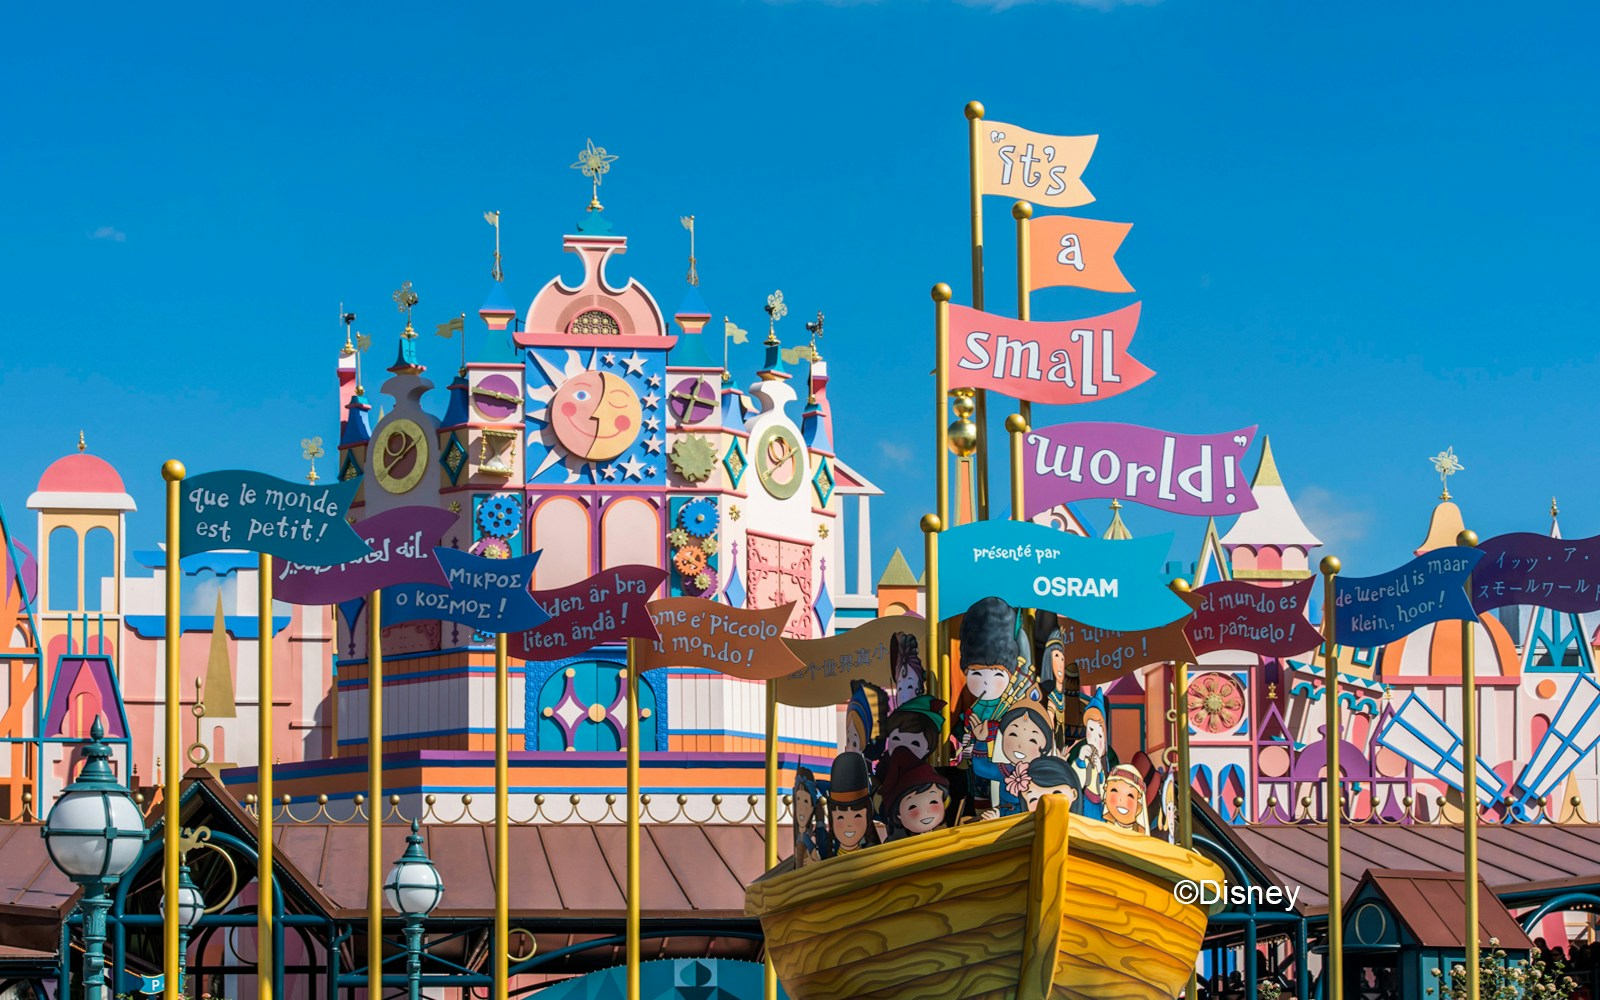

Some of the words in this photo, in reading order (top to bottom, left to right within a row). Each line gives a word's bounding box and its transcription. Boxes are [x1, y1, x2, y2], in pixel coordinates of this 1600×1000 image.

[1056, 233, 1086, 272] a
[957, 328, 1122, 396] small
[1026, 433, 1248, 505] world!"
[188, 487, 230, 513] que
[239, 483, 257, 506] le
[264, 489, 338, 517] monde
[196, 520, 232, 543] est
[247, 515, 329, 543] petit!
[973, 544, 1032, 563] présenté
[1035, 549, 1061, 565] par
[589, 584, 610, 604] är
[614, 573, 647, 595] bra
[1033, 575, 1119, 598] OSRAM
[1336, 589, 1353, 608] de
[1412, 569, 1425, 586] is
[1427, 558, 1469, 575] maar
[1218, 592, 1276, 614] mundo
[1279, 595, 1298, 611] es
[522, 629, 569, 653] liten
[1193, 625, 1216, 643] un
[671, 635, 743, 664] mondo
[1075, 646, 1135, 674] mdogo
